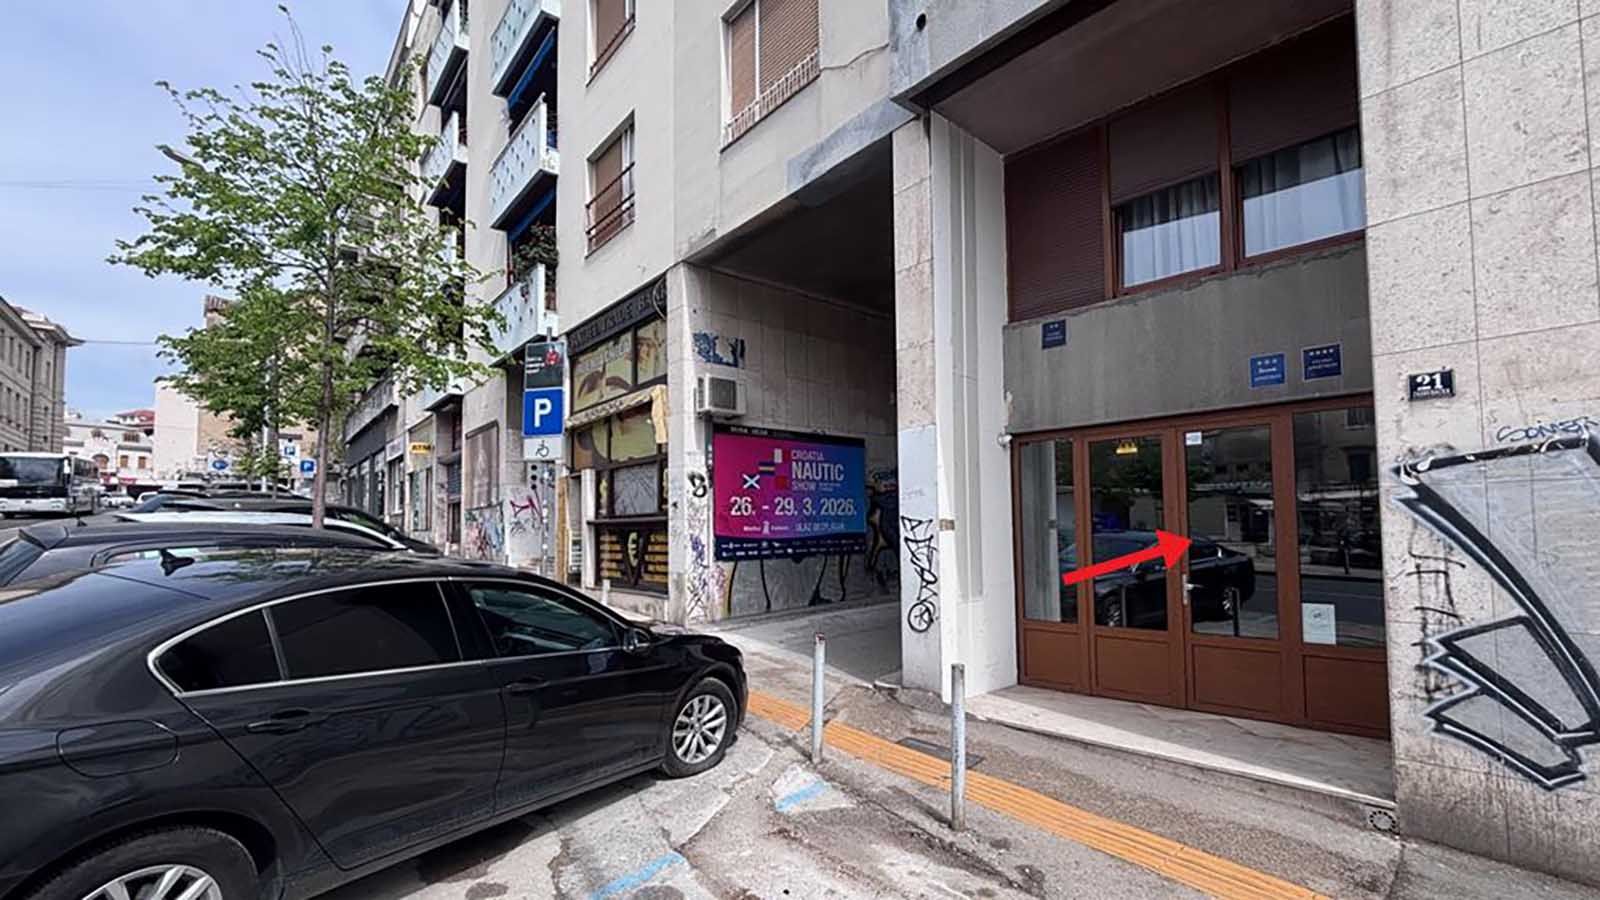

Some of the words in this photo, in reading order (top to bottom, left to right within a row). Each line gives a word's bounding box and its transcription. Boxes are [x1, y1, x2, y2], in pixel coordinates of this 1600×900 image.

[1416, 373, 1443, 391] 21
[534, 398, 552, 428] P
[791, 450, 825, 461] CROATIA
[792, 462, 845, 481] NAUTIC
[792, 481, 816, 491] SHOW
[730, 496, 756, 516] 26.
[774, 497, 798, 516] 29.
[803, 498, 816, 516] 3.
[820, 498, 857, 516] 2026.
